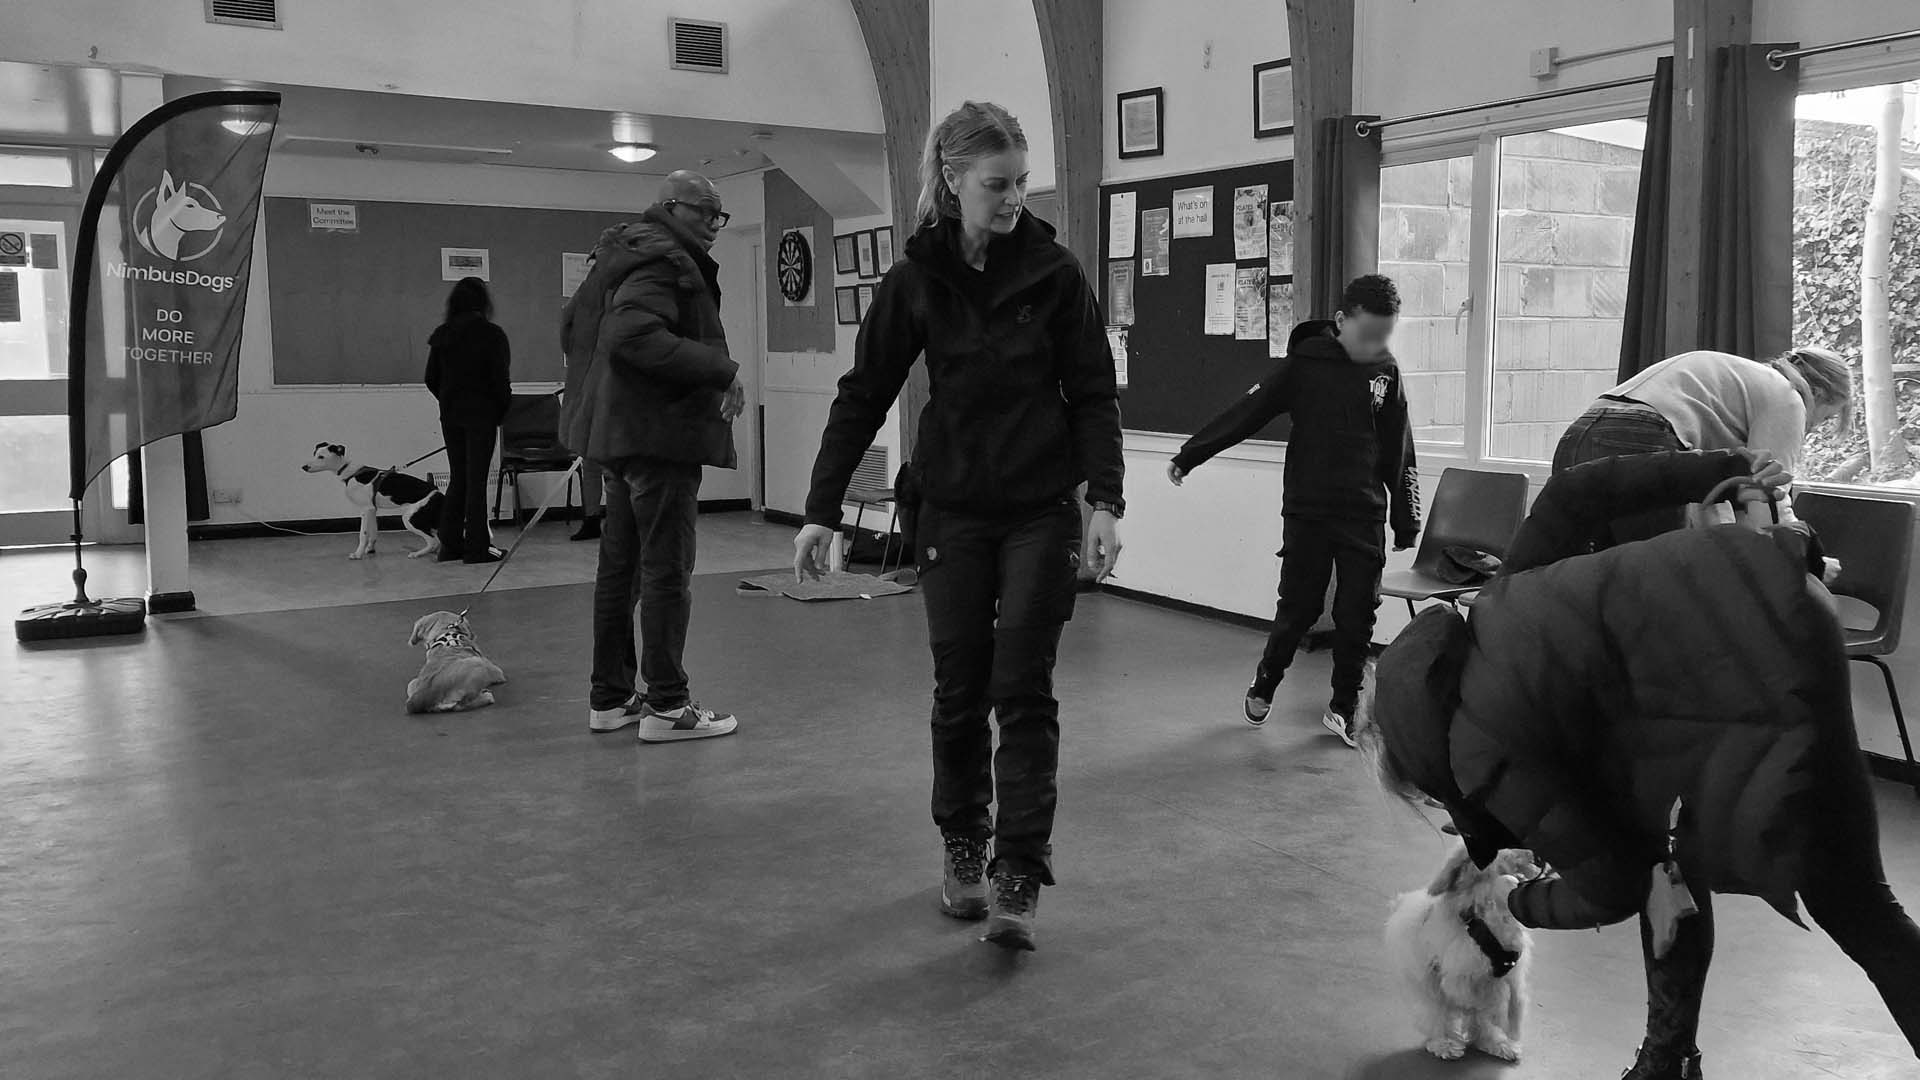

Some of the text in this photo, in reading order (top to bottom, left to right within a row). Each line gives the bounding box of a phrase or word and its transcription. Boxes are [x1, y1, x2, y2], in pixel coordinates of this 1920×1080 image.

[316, 207, 350, 216] Meet the
[1177, 200, 1208, 210] What's on
[312, 216, 355, 225] Committee
[1177, 212, 1208, 225] at the hall
[106, 262, 234, 293] NimbusDogs
[156, 308, 183, 323] DO
[142, 327, 195, 345] MORE
